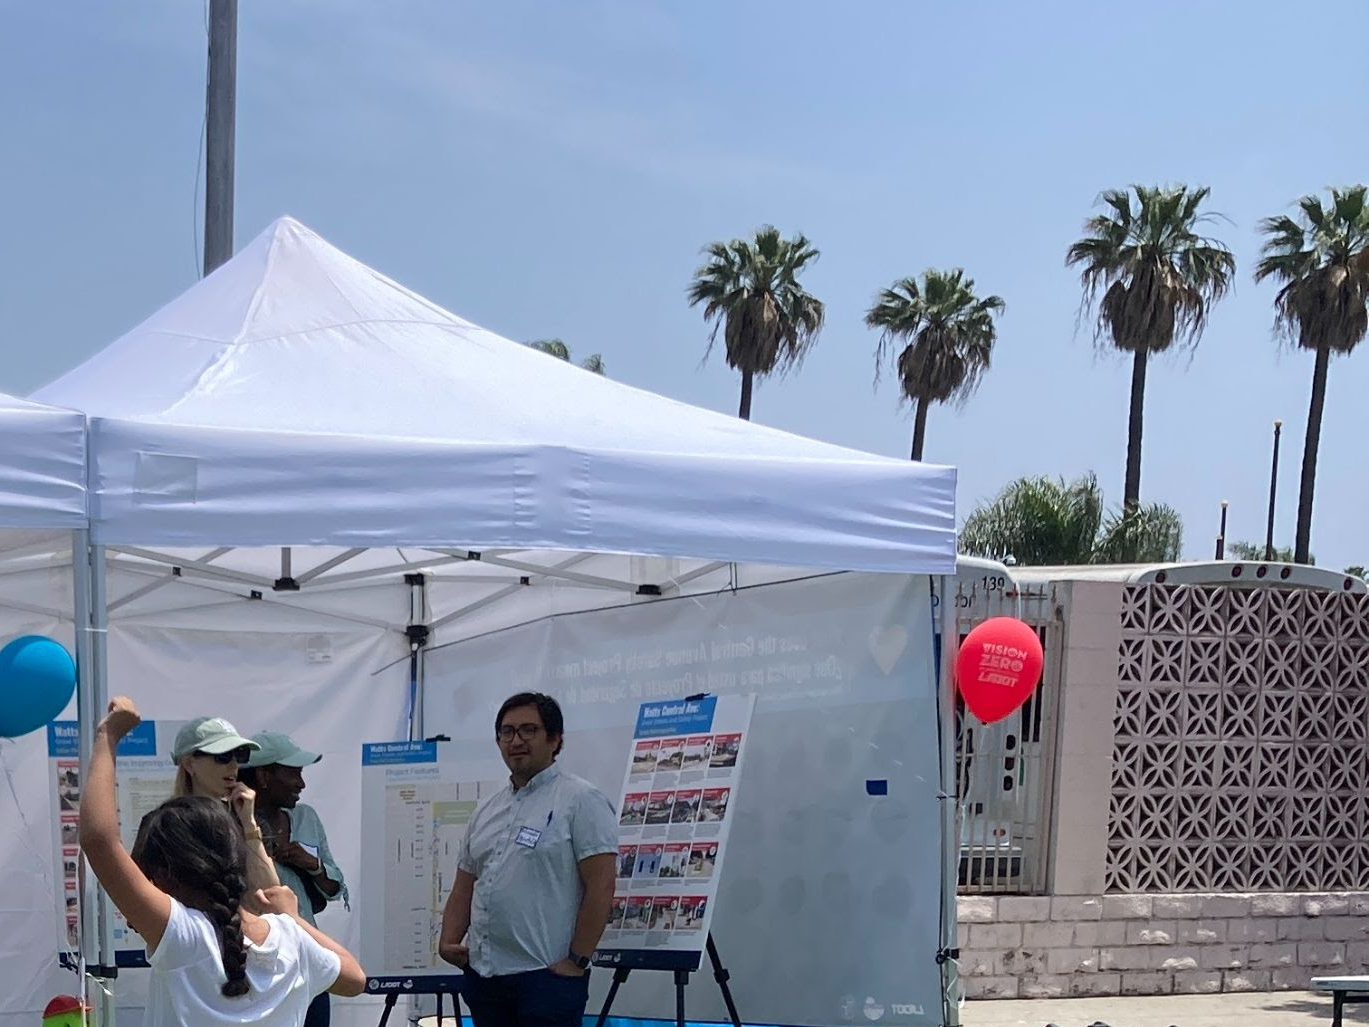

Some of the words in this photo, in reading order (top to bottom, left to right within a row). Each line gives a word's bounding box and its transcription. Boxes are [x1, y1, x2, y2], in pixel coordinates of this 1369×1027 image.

[981, 575, 1005, 591] 139
[982, 643, 1028, 661] VISION
[979, 654, 1024, 672] ZERO
